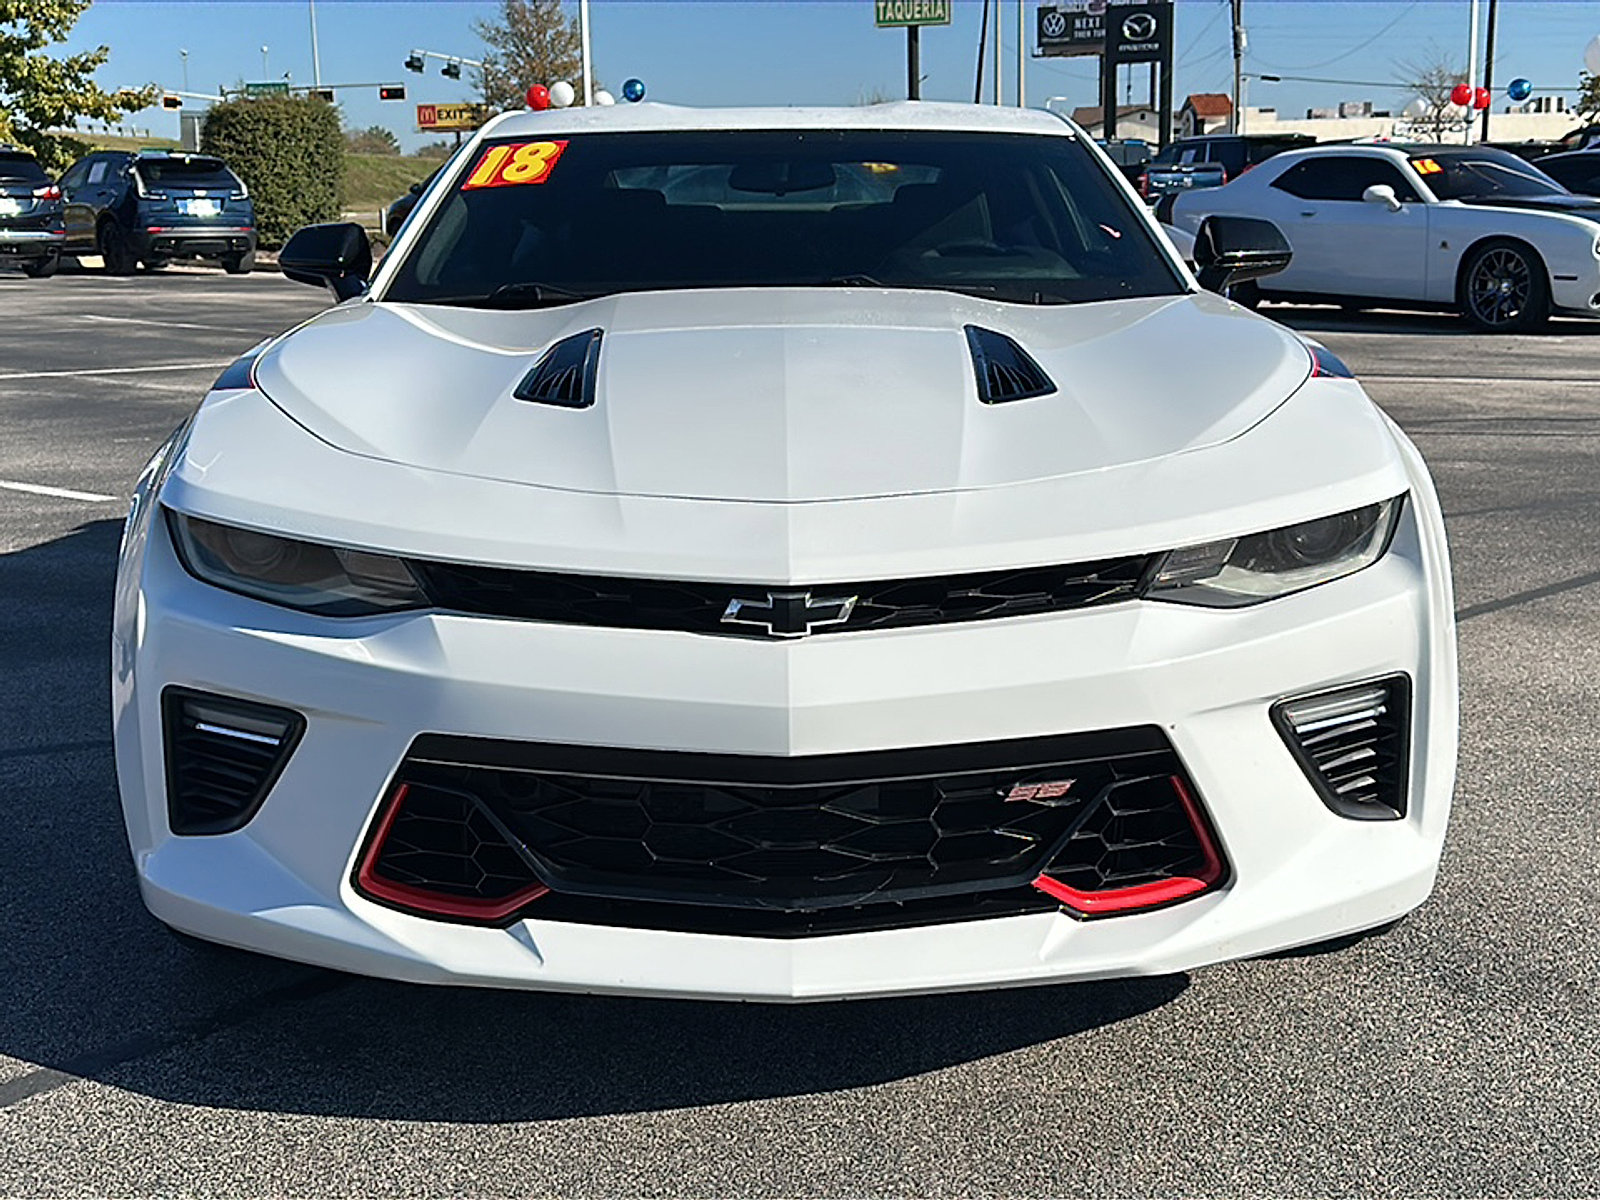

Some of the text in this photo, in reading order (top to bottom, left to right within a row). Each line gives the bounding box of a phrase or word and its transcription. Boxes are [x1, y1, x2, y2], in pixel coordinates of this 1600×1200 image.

[878, 1, 945, 21] TAQUERIA
[437, 109, 463, 120] EXIT
[468, 142, 560, 187] 18
[1003, 781, 1071, 802] SS
